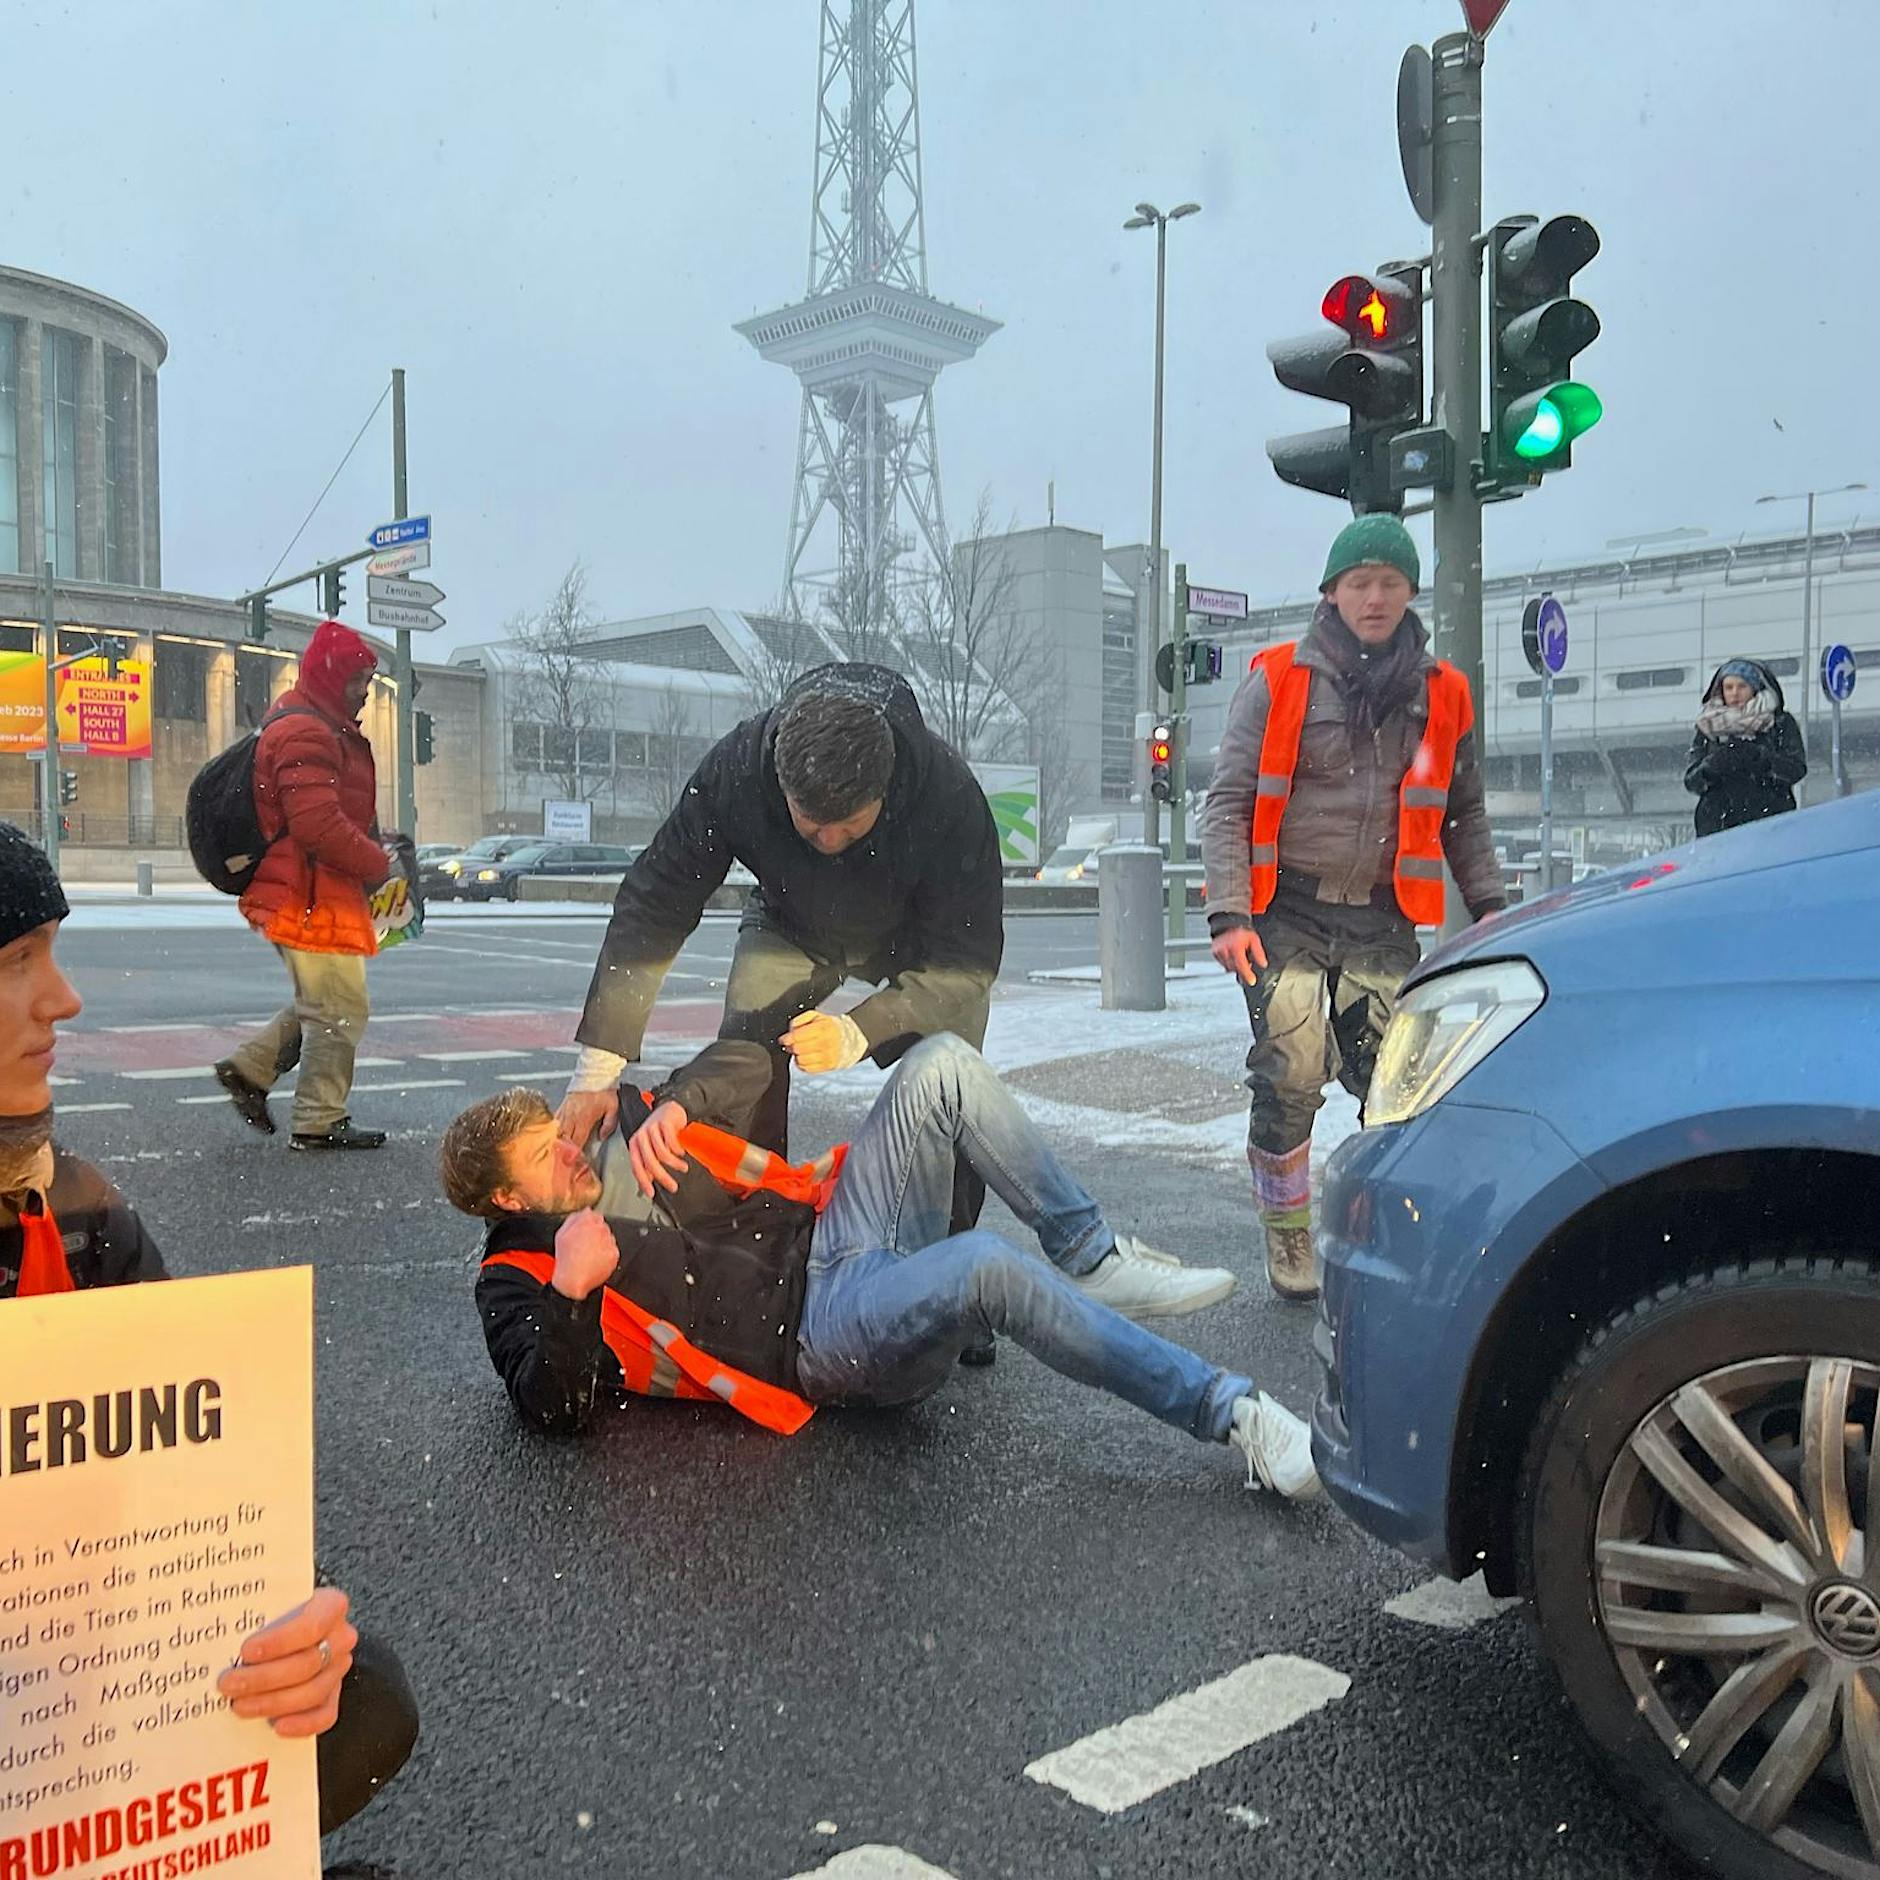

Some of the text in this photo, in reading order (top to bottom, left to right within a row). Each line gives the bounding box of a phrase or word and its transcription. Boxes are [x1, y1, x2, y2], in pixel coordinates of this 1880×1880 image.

[378, 609, 428, 624] Busbahnhof
[385, 584, 422, 598] Zentrum
[70, 669, 131, 683] ENTRAES
[82, 688, 121, 701] NORTH
[15, 705, 44, 718] 2023
[83, 705, 124, 718] HALL 27
[83, 718, 120, 729] SOUTH
[83, 730, 110, 742] HALL
[0, 1379, 221, 1476] ERUNG
[0, 1501, 265, 1575] ch in Verantwortung für
[2, 1541, 264, 1613] ationen die natürlichen
[1, 1577, 265, 1653] nd die Tiere im Rahmen
[58, 1638, 160, 1676] Ordnung
[168, 1615, 227, 1649] durch
[235, 1608, 265, 1633] die
[21, 1661, 209, 1727] nach Maßgabe
[0, 1735, 65, 1772] durch
[82, 1722, 116, 1748] die
[0, 1758, 140, 1812] tsprechung.
[0, 1759, 270, 1880] RUNDGESETZ
[101, 1821, 270, 1880] UTSCHLAND
